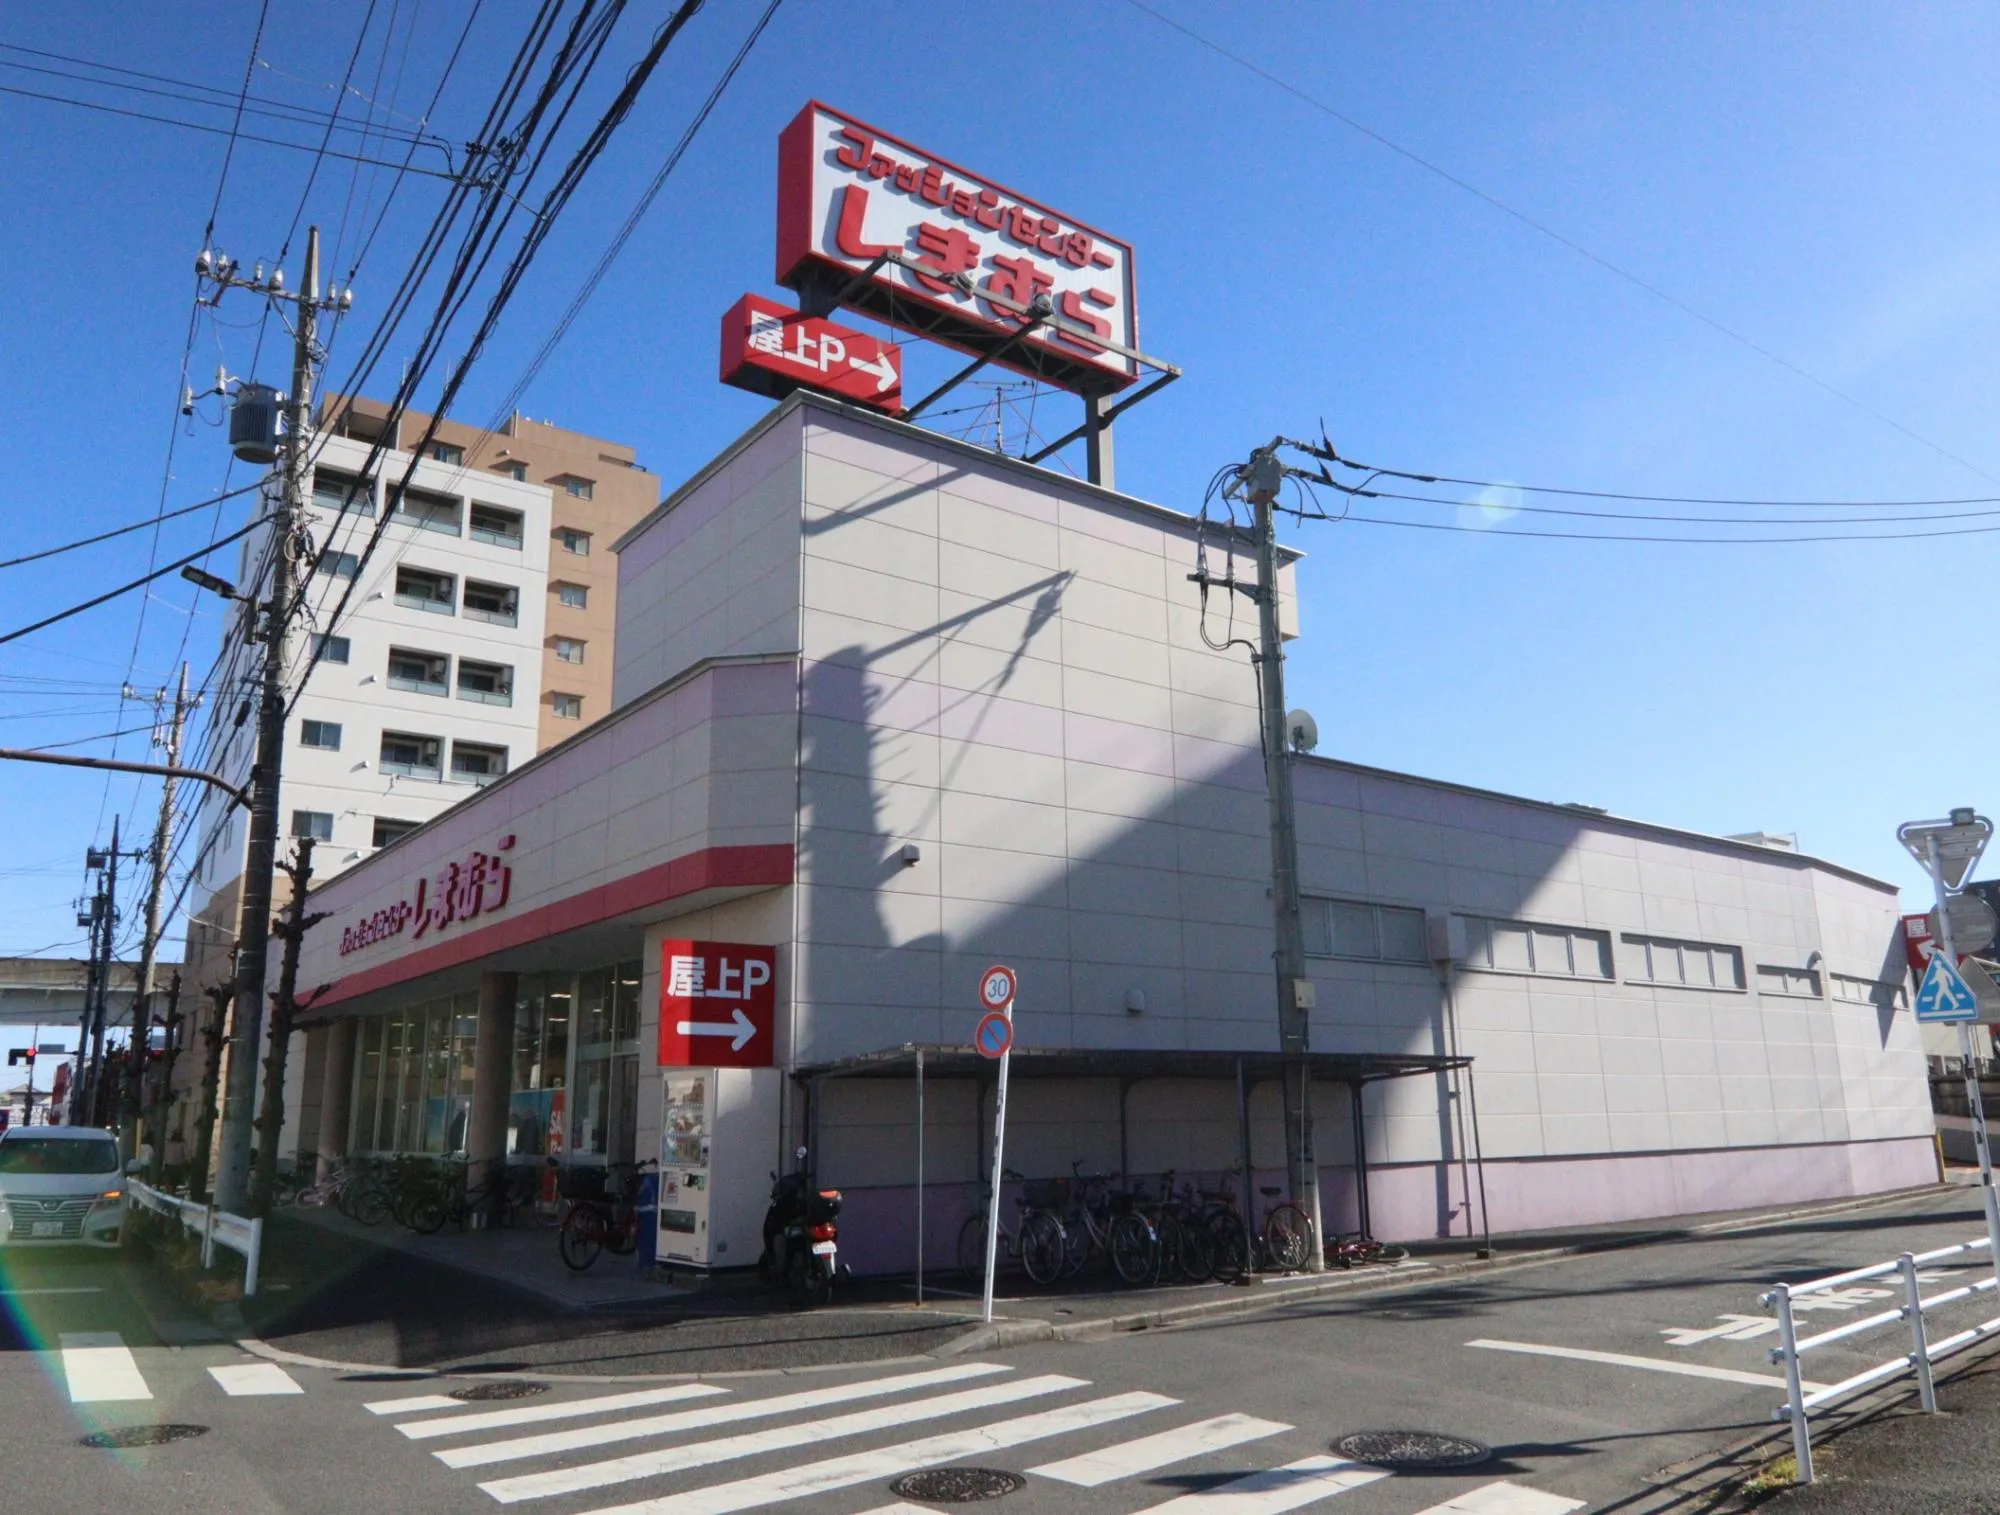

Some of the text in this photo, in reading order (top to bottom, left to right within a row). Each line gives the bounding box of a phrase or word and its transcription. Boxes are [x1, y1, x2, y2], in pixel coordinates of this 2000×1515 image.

[836, 126, 1114, 268] ファッションセンター
[836, 183, 1115, 354] しまむら
[748, 310, 845, 372] 屋上P
[412, 835, 516, 939] しまむら
[667, 955, 770, 1000] 屋上P
[987, 978, 1008, 998] 30
